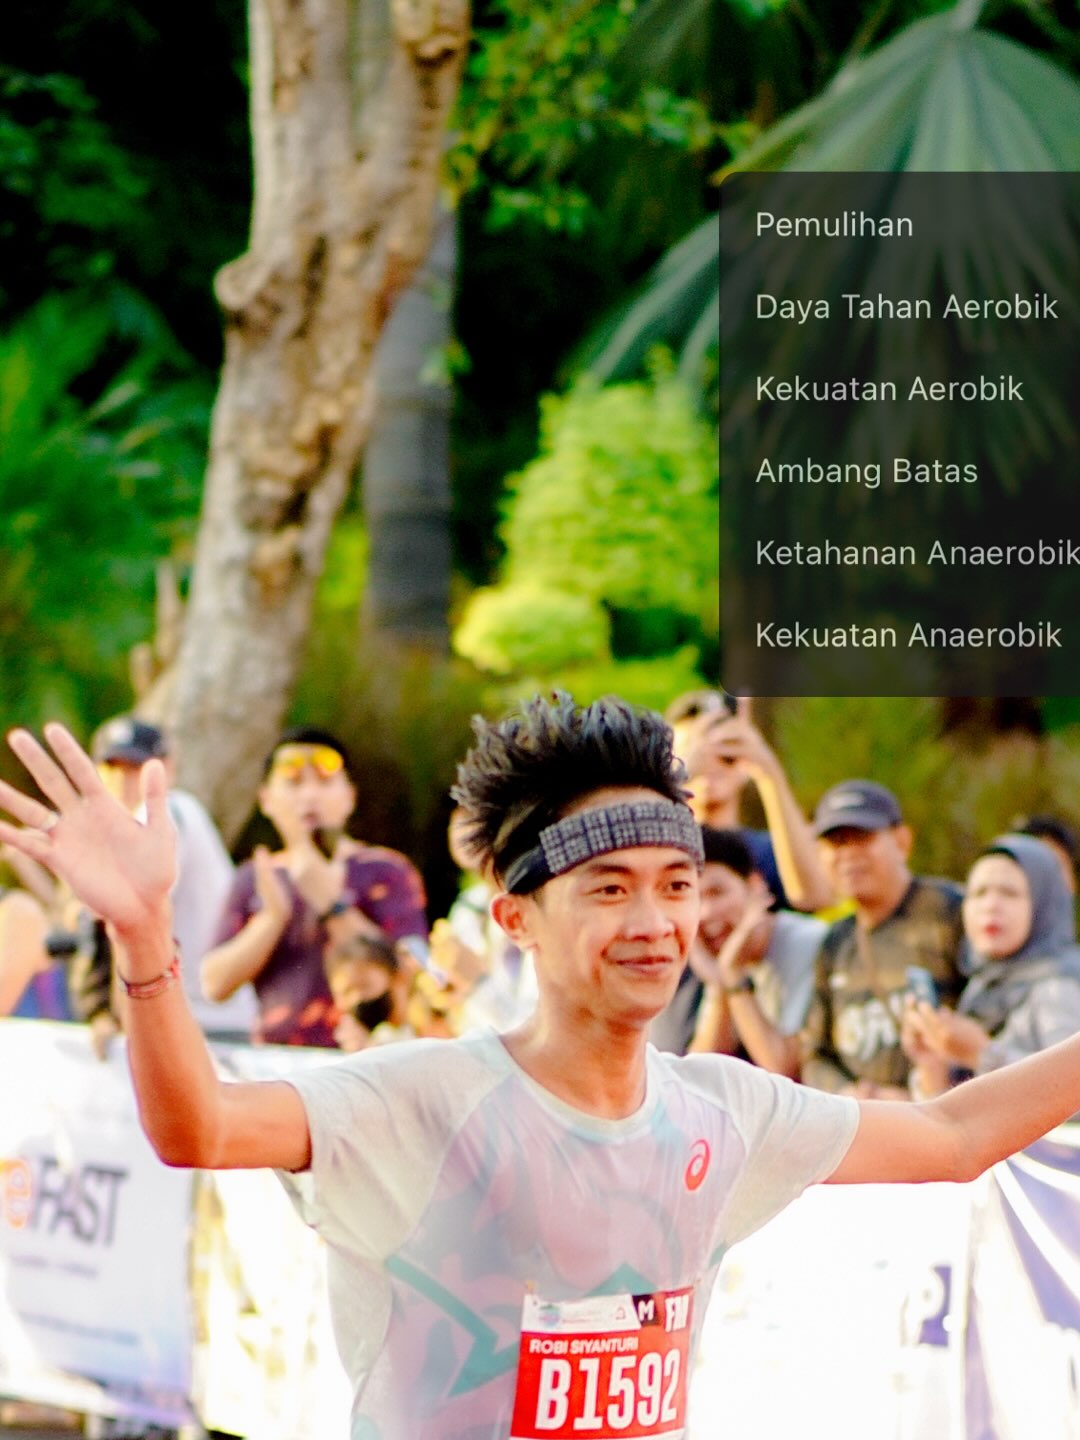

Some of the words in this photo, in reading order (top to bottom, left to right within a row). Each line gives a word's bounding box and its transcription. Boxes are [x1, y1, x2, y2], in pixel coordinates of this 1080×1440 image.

[637, 1299, 655, 1322] M
[529, 1338, 569, 1355] ROBI
[570, 1336, 639, 1355] SIYANTURI
[534, 1348, 681, 1431] B1592
